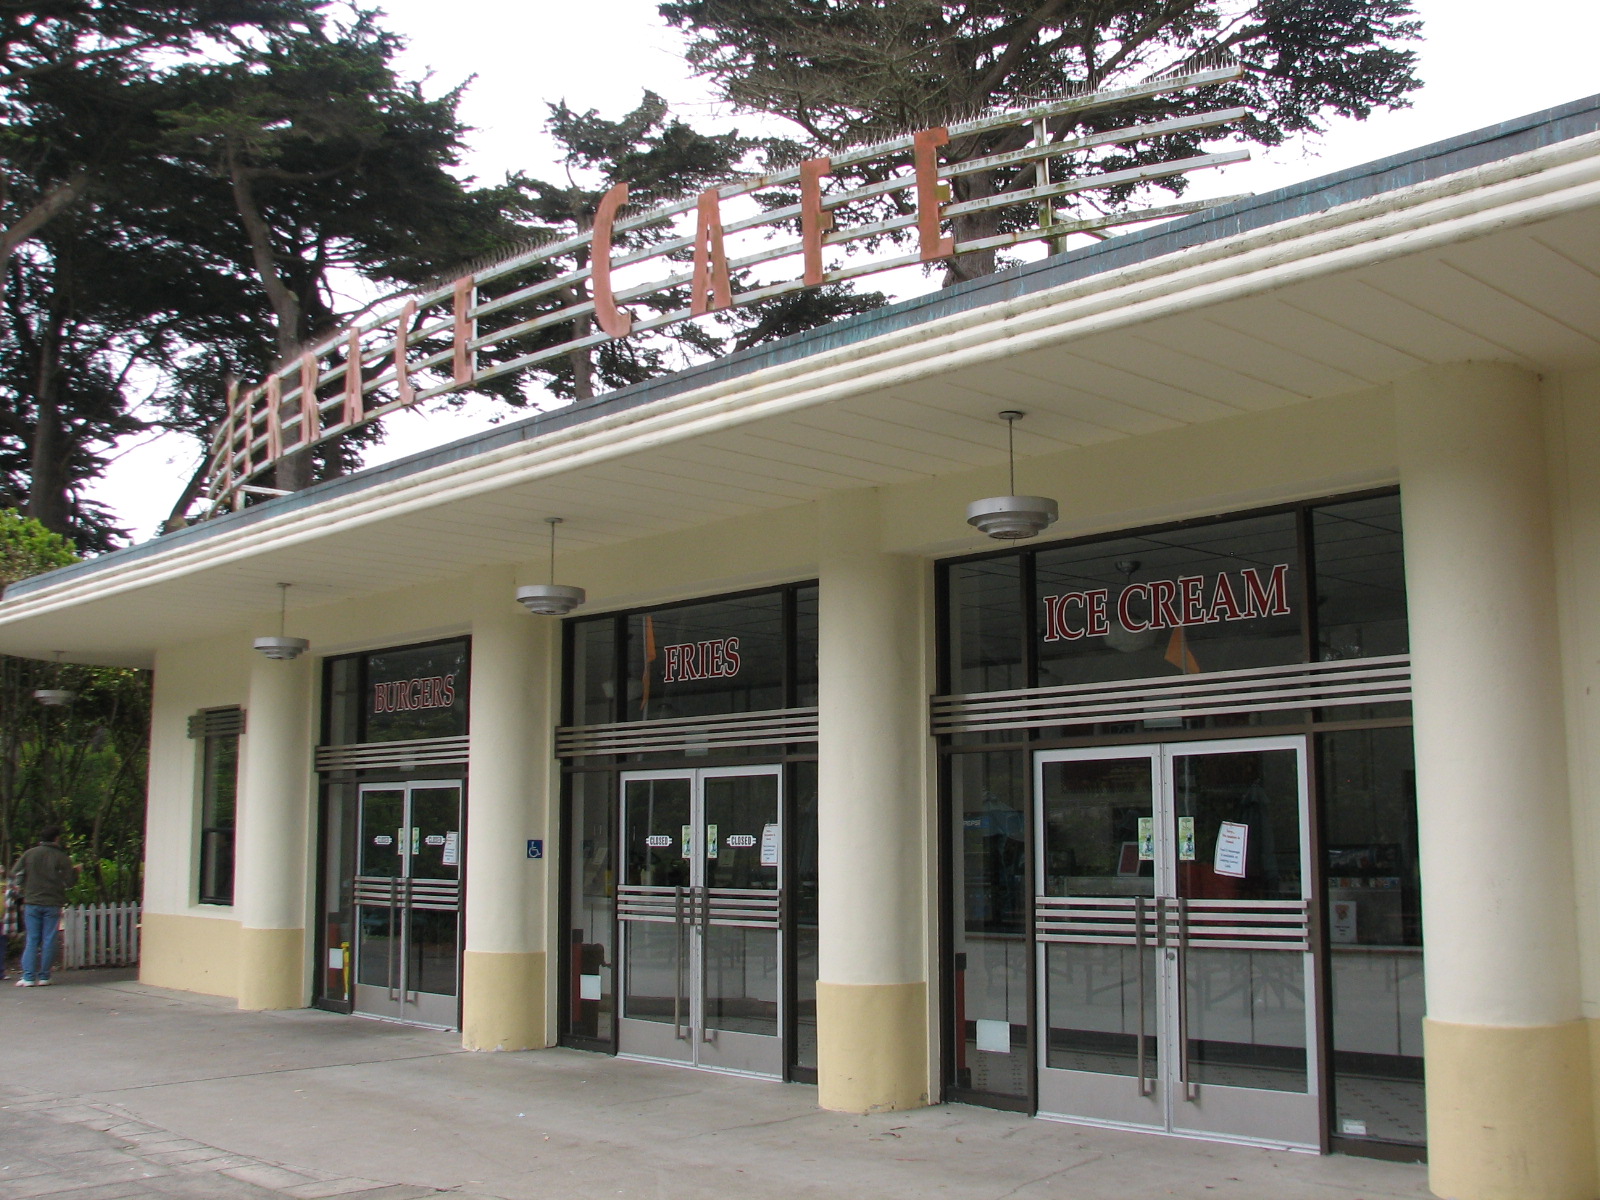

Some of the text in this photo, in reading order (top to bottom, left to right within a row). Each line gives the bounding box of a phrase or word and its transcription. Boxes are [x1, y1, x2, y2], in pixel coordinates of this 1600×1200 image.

[228, 126, 954, 491] TERRACE CAFE
[1043, 563, 1291, 642] ICE CREAM
[664, 636, 741, 683] FRIES
[374, 674, 455, 713] BURGERS
[649, 836, 669, 846] CLOSED
[730, 836, 752, 846] CLOSED
